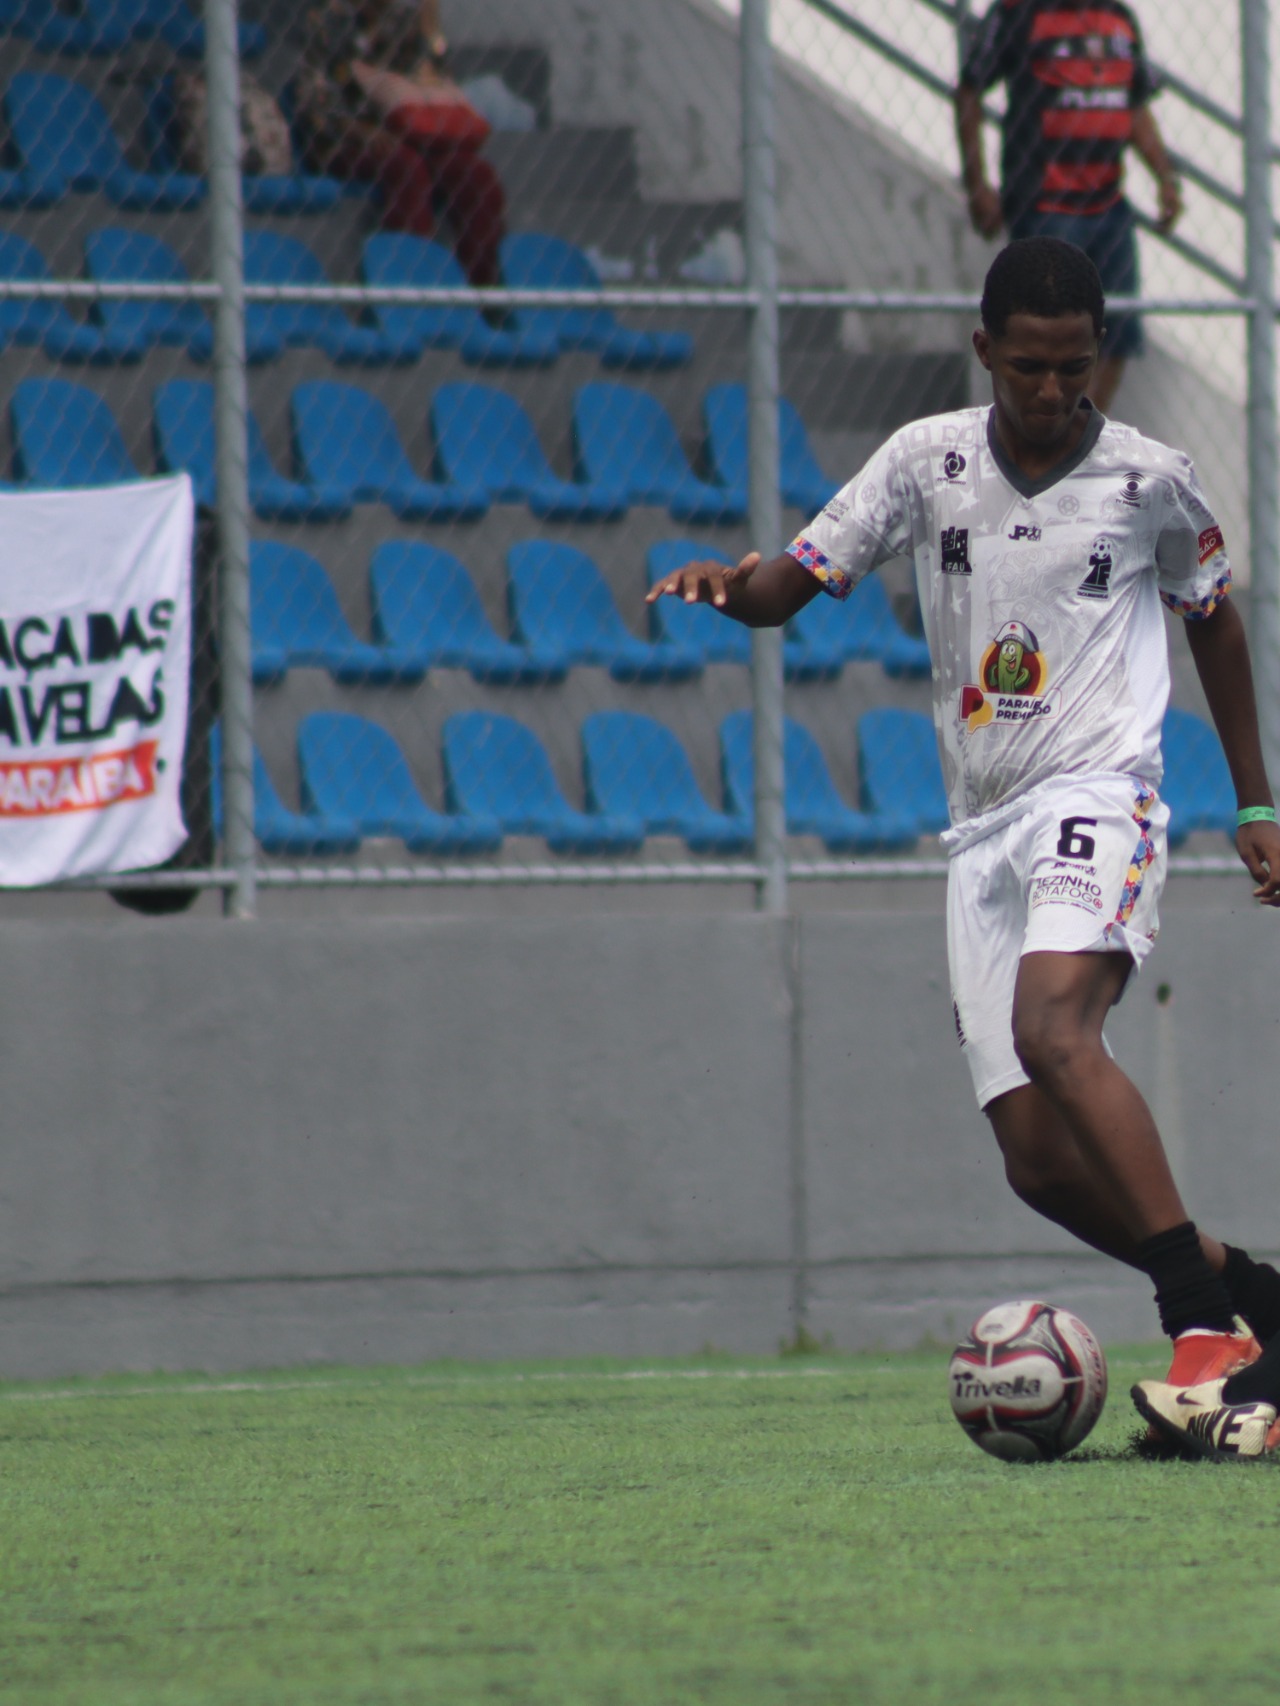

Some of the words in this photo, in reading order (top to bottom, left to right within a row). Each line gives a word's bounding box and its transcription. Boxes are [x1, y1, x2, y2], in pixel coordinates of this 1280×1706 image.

[1057, 816, 1098, 861] 6
[953, 1375, 1042, 1398] Trivella
[1187, 1407, 1258, 1453] NIKE
